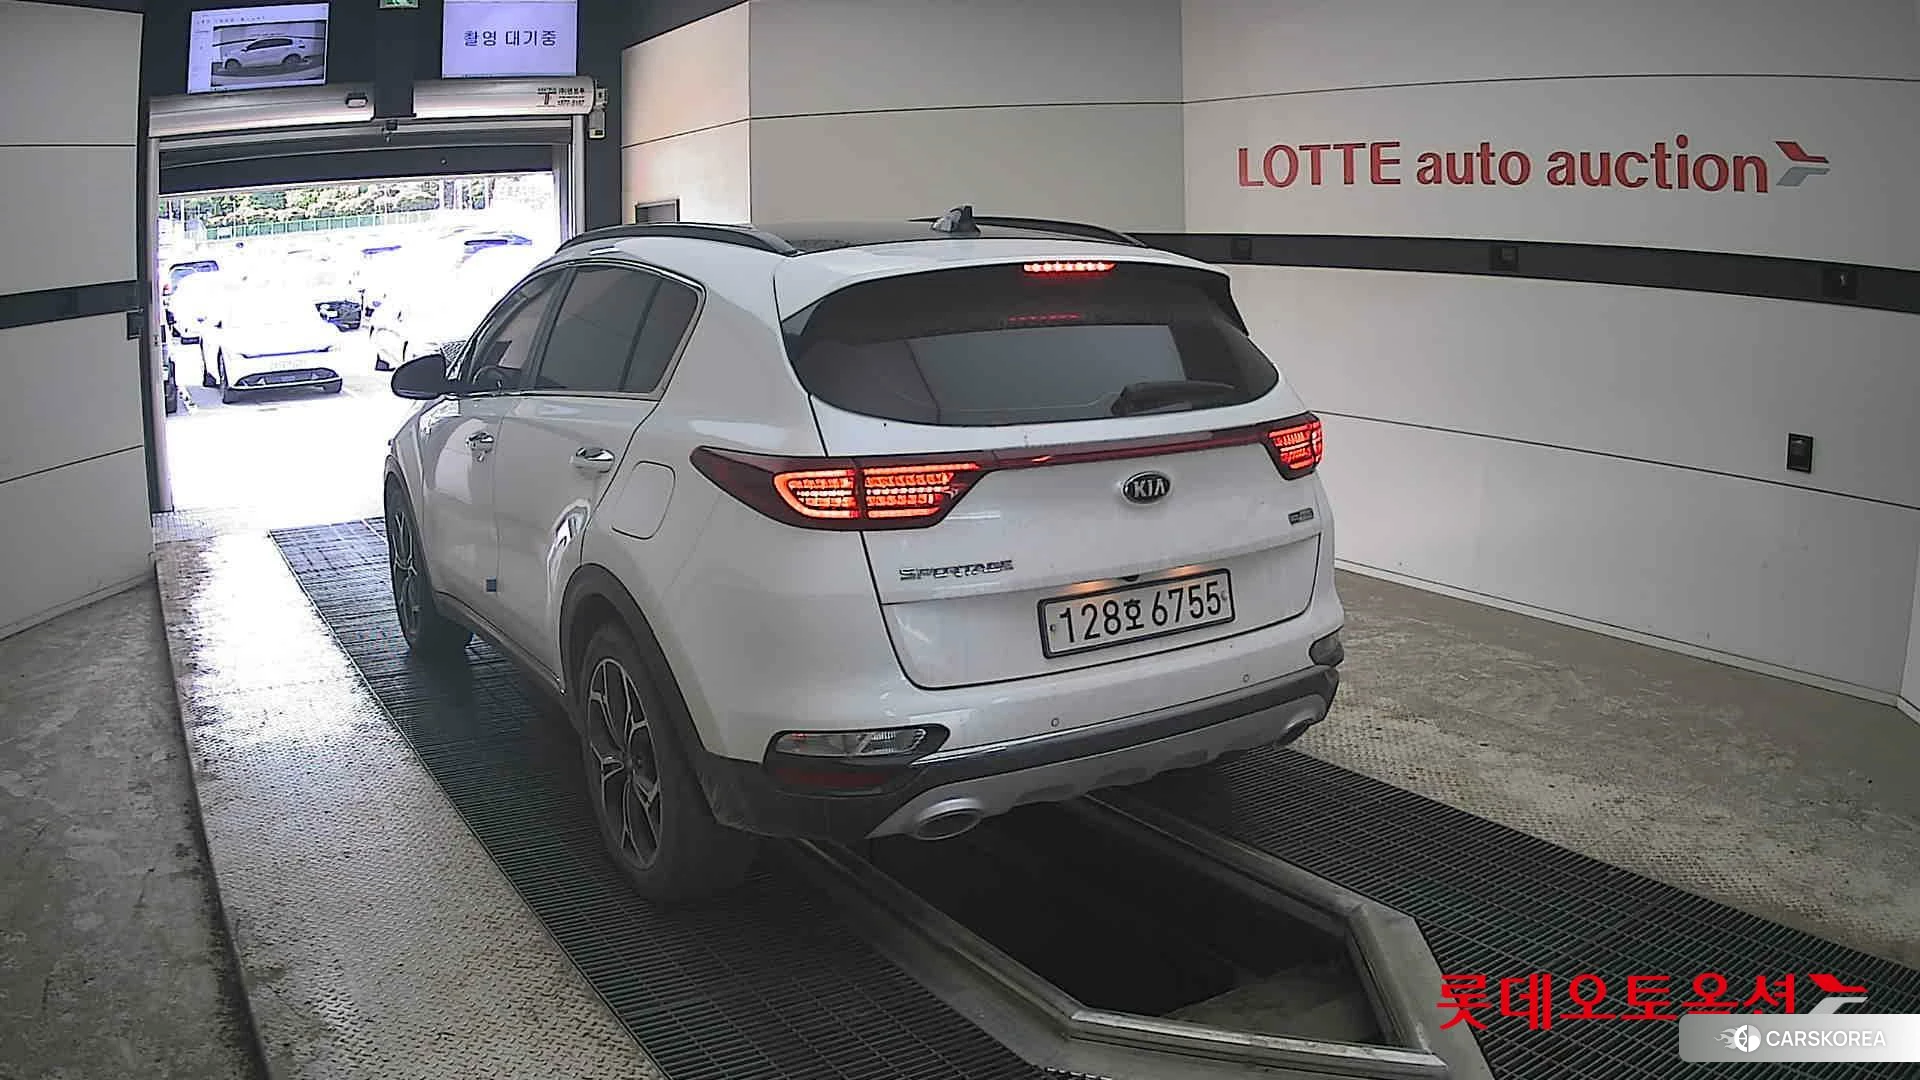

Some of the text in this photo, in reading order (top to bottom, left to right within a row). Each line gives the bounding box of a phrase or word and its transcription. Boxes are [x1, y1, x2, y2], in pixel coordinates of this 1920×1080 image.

[464, 30, 557, 47] 촬영 대기중
[1237, 134, 1768, 193] LOTTE auto auction
[1133, 478, 1165, 497] KIA
[899, 559, 1014, 581] SPORTAGE
[1059, 580, 1222, 643] 128호 6755
